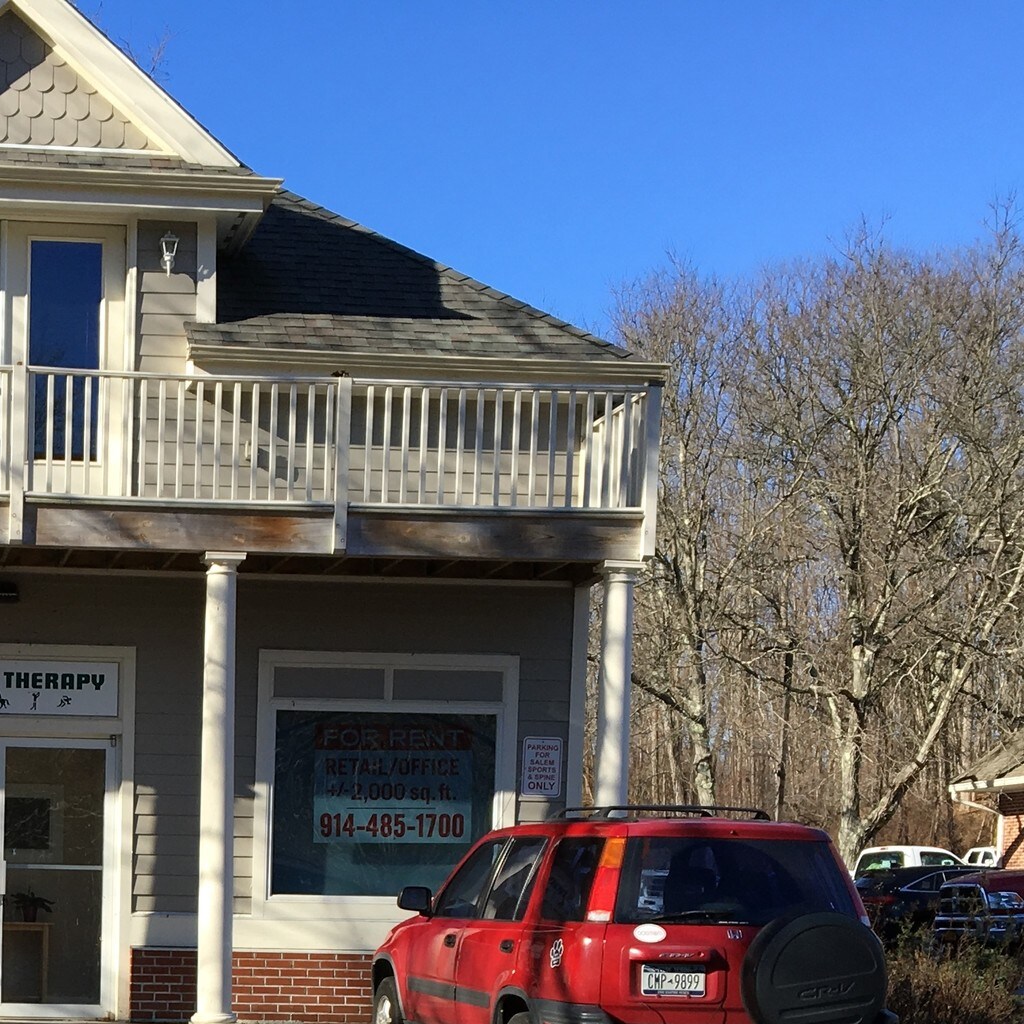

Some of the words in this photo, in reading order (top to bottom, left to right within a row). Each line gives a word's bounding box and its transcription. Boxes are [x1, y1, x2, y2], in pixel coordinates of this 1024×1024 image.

[4, 671, 105, 690] THERAPY
[323, 729, 379, 747] FOR
[389, 729, 464, 747] RENT
[325, 757, 460, 776] RETAIL/OFFICE
[410, 787, 436, 804] sq.
[440, 783, 457, 801] ft.
[528, 782, 555, 790] ONLY
[320, 812, 465, 838] 914-485-1700
[647, 973, 667, 989] CMP
[674, 973, 700, 990] 9899
[800, 981, 856, 1001] CR-V
